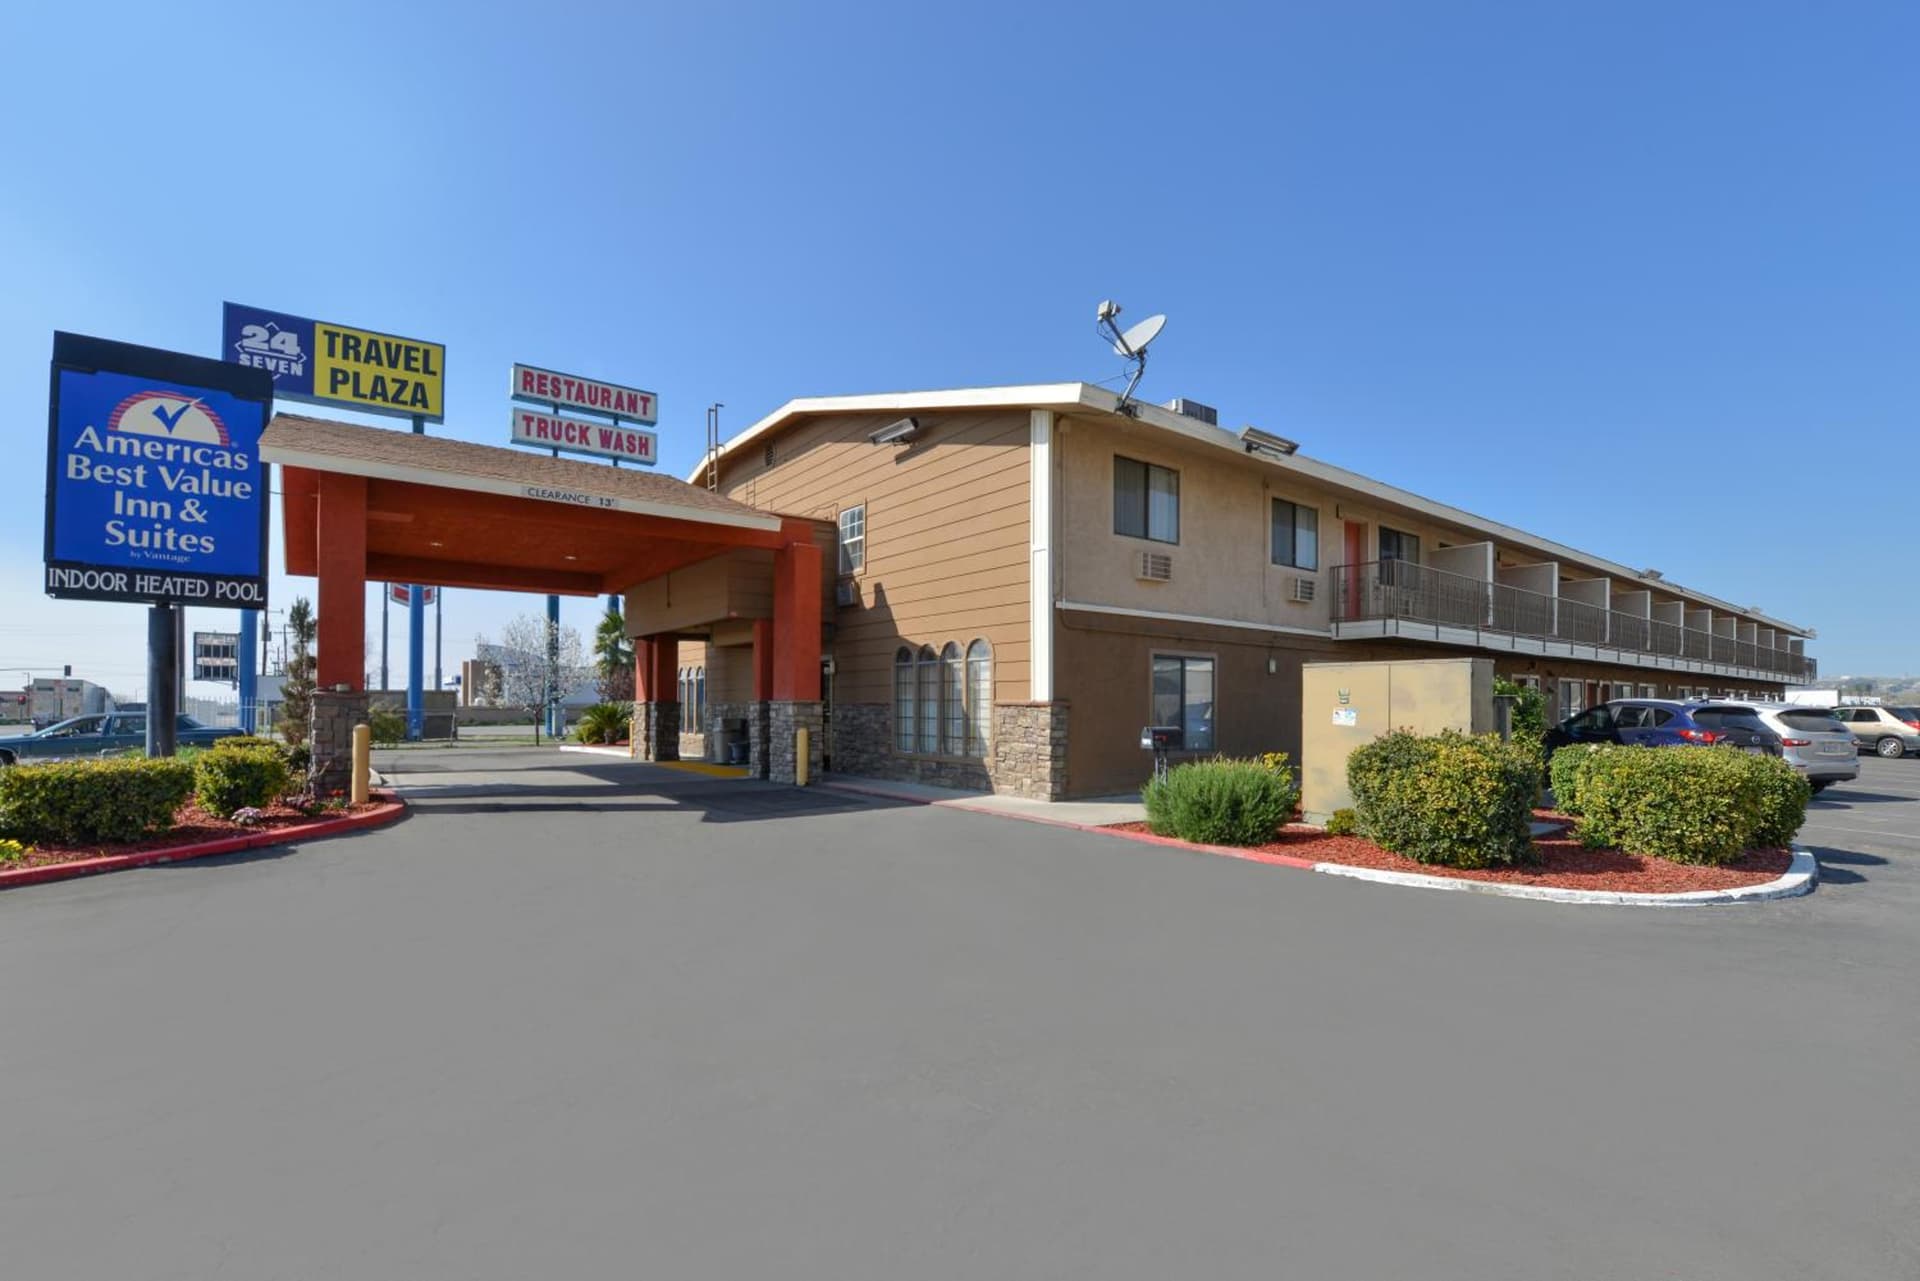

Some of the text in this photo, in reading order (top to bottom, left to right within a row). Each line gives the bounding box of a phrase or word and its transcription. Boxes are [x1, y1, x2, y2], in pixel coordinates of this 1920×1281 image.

[241, 323, 301, 356] 24
[323, 330, 437, 376] TRAVEL
[239, 354, 303, 376] SEVEN
[329, 367, 430, 410] PLAZA
[522, 370, 651, 416] RESTAURANT
[74, 425, 249, 471] Americas
[522, 414, 649, 456] TRUCK WASH
[67, 453, 252, 499] Best Value
[114, 490, 208, 523] Inn &
[527, 487, 592, 504] CLEARANCE
[105, 520, 215, 554] Suites
[130, 550, 191, 564] by Vantage
[48, 568, 264, 601] INDOOR HEATED POOL
